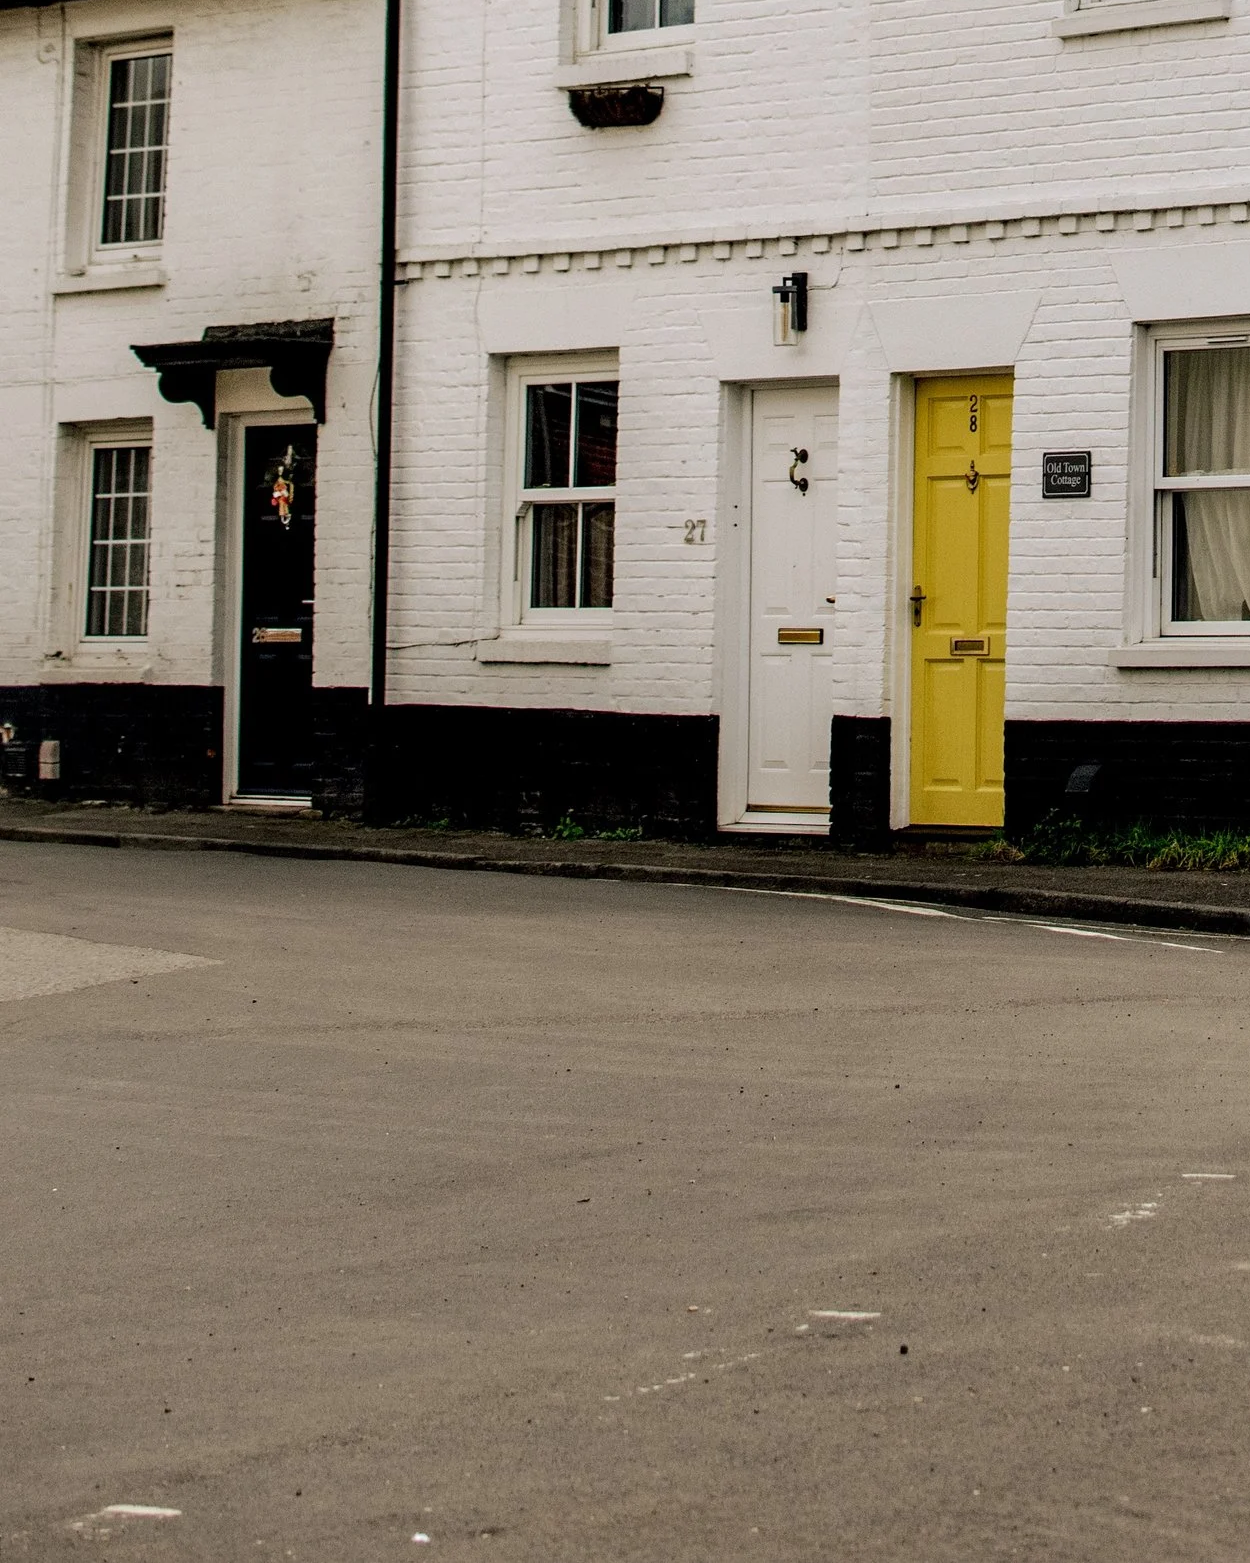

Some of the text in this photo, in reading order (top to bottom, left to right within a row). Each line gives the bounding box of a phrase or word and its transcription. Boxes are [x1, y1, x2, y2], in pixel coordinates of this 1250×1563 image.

[969, 394, 978, 433] 28
[1046, 462, 1086, 474] Old Town
[1050, 474, 1081, 488] Cottage
[684, 519, 706, 544] 27
